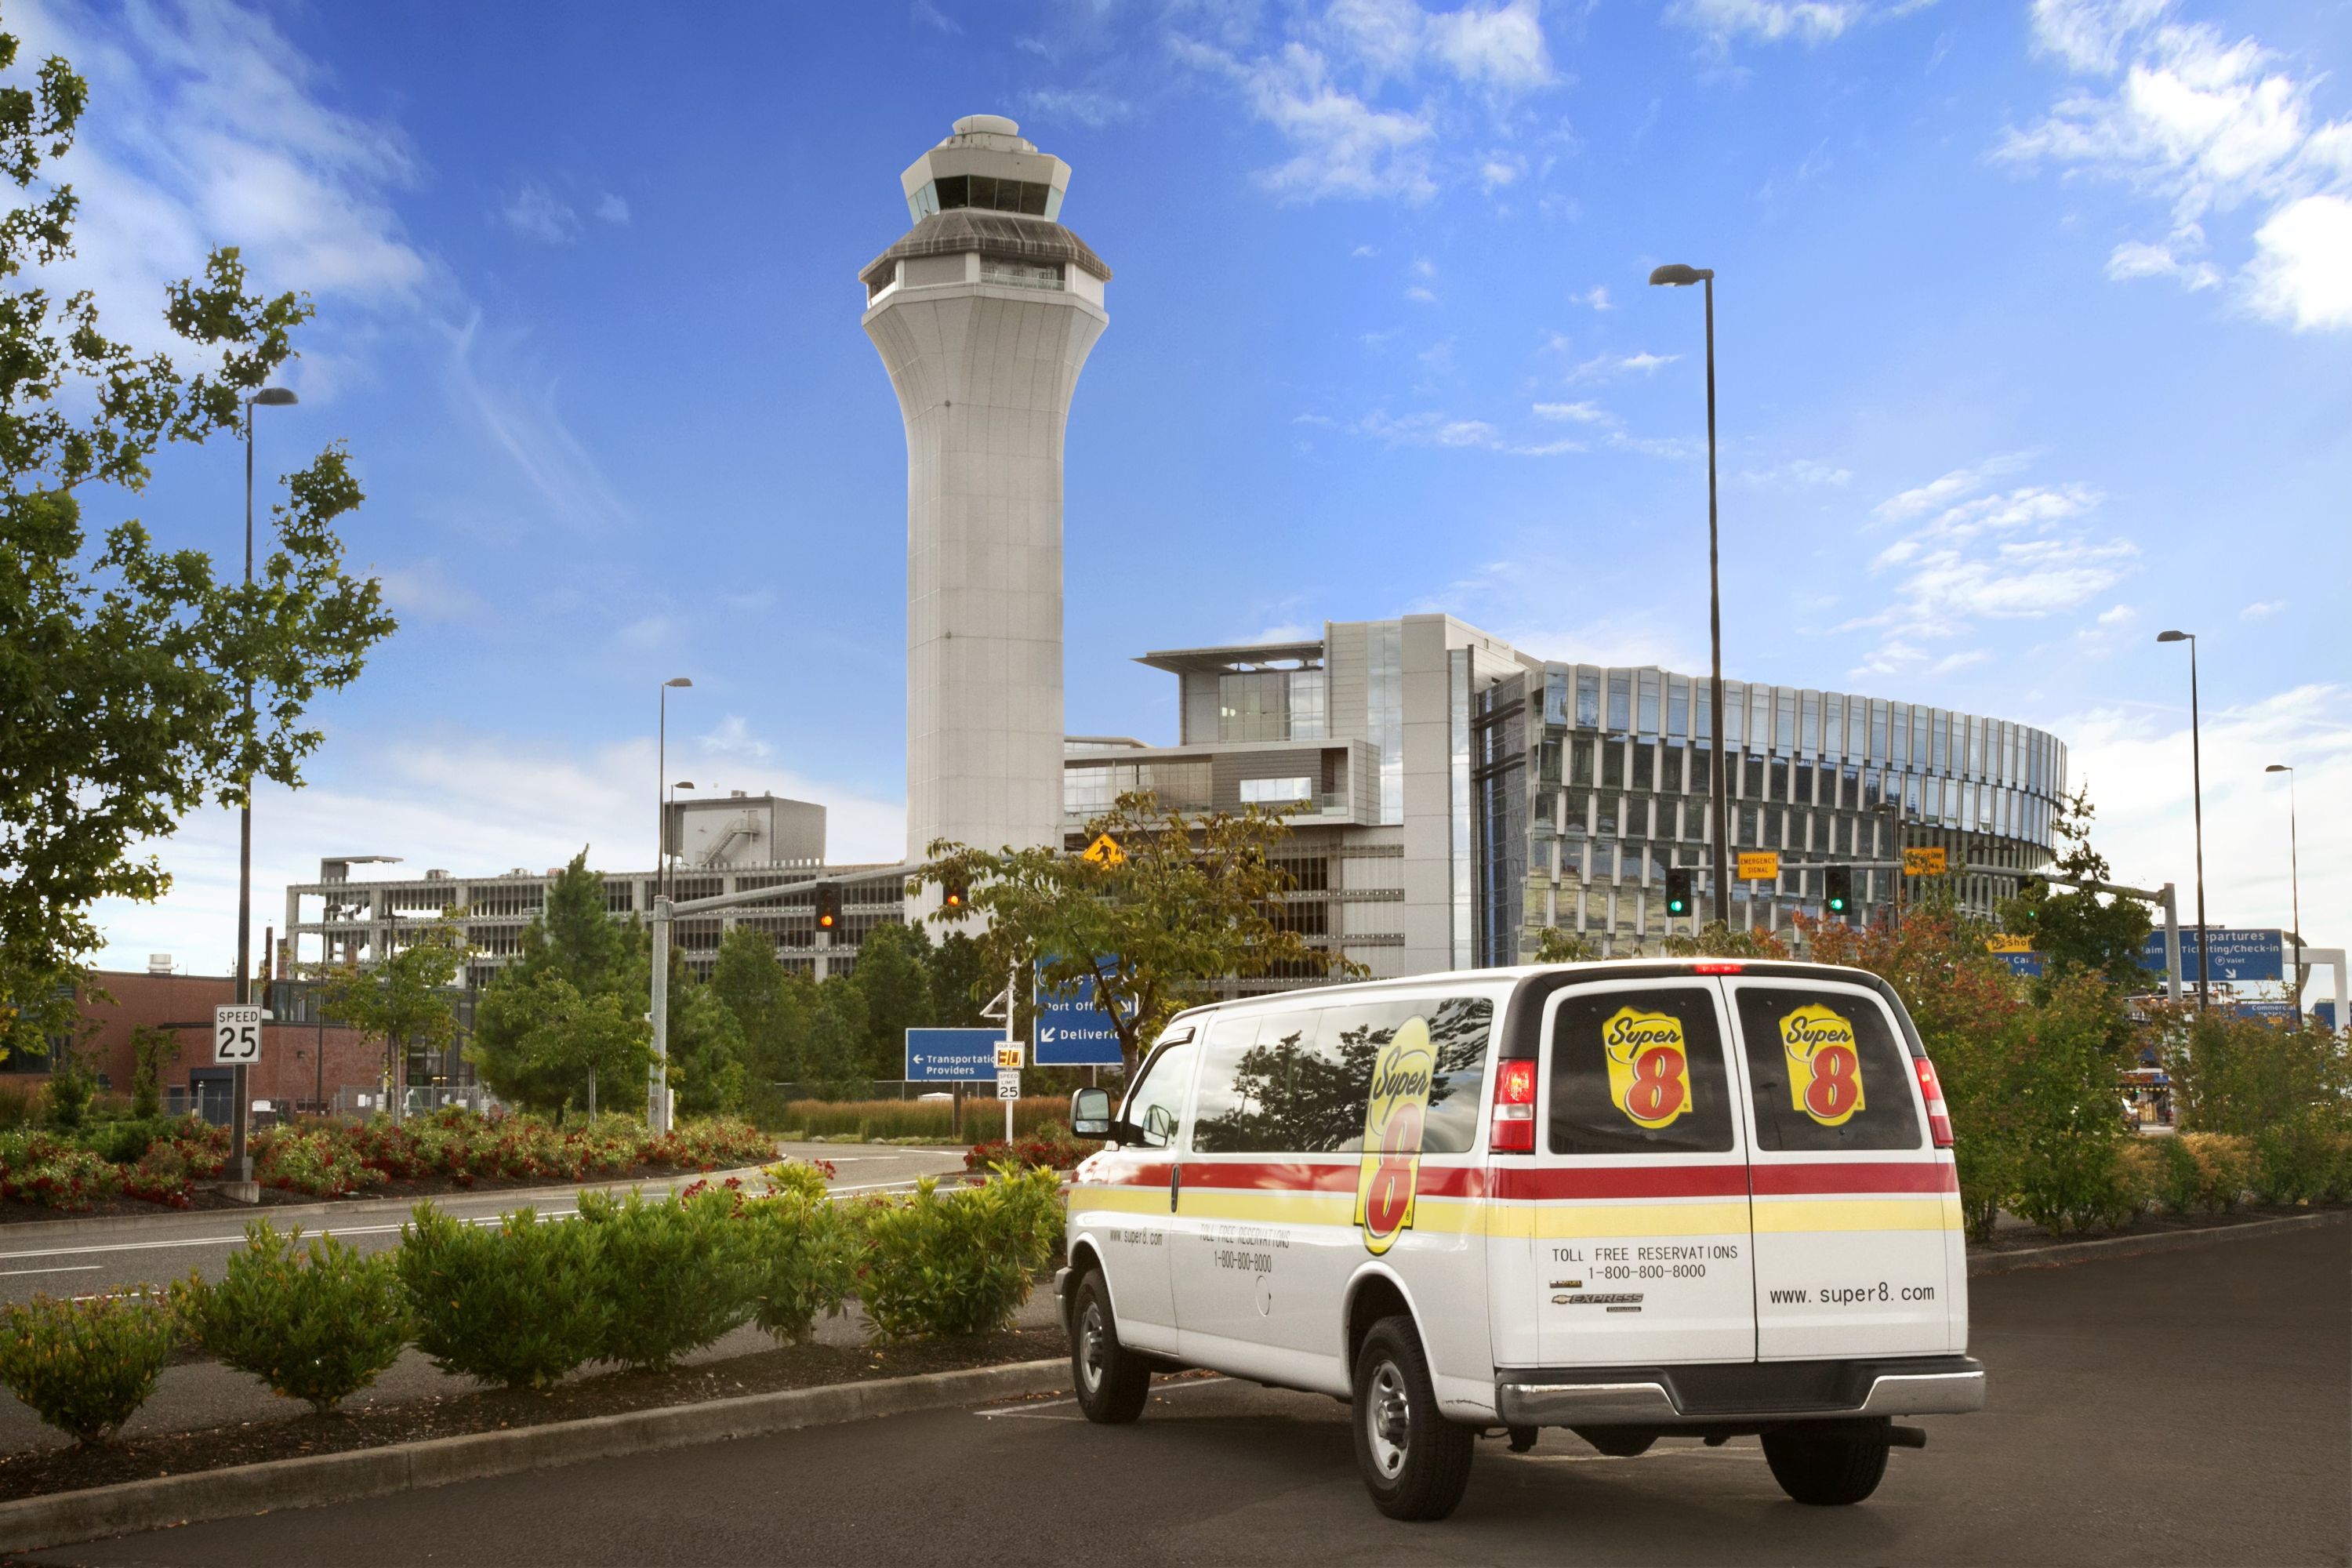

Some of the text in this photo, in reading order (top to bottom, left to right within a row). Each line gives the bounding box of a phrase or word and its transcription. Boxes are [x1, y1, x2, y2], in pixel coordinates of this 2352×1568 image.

[2181, 944, 2279, 955] Ticting/Check-in
[219, 1011, 258, 1022] SPEED
[219, 1027, 256, 1058] 25
[1607, 1016, 1682, 1059] Super
[1786, 1015, 1852, 1058] Super
[927, 1054, 994, 1065] Transportatio
[998, 1050, 1021, 1065] 30
[926, 1066, 975, 1075] Providers
[1372, 1045, 1429, 1127] Super
[1624, 1047, 1685, 1121] 8
[1805, 1045, 1858, 1119] 8
[1000, 1087, 1018, 1098] 25
[1365, 1102, 1422, 1239] 8
[1214, 1250, 1272, 1272] 1-800-800-8000
[1552, 1245, 1738, 1262] TOLL FREE RESERVATIONS
[1588, 1264, 1706, 1279] 1-800-800-8000
[1570, 1294, 1643, 1304] EXPRESS
